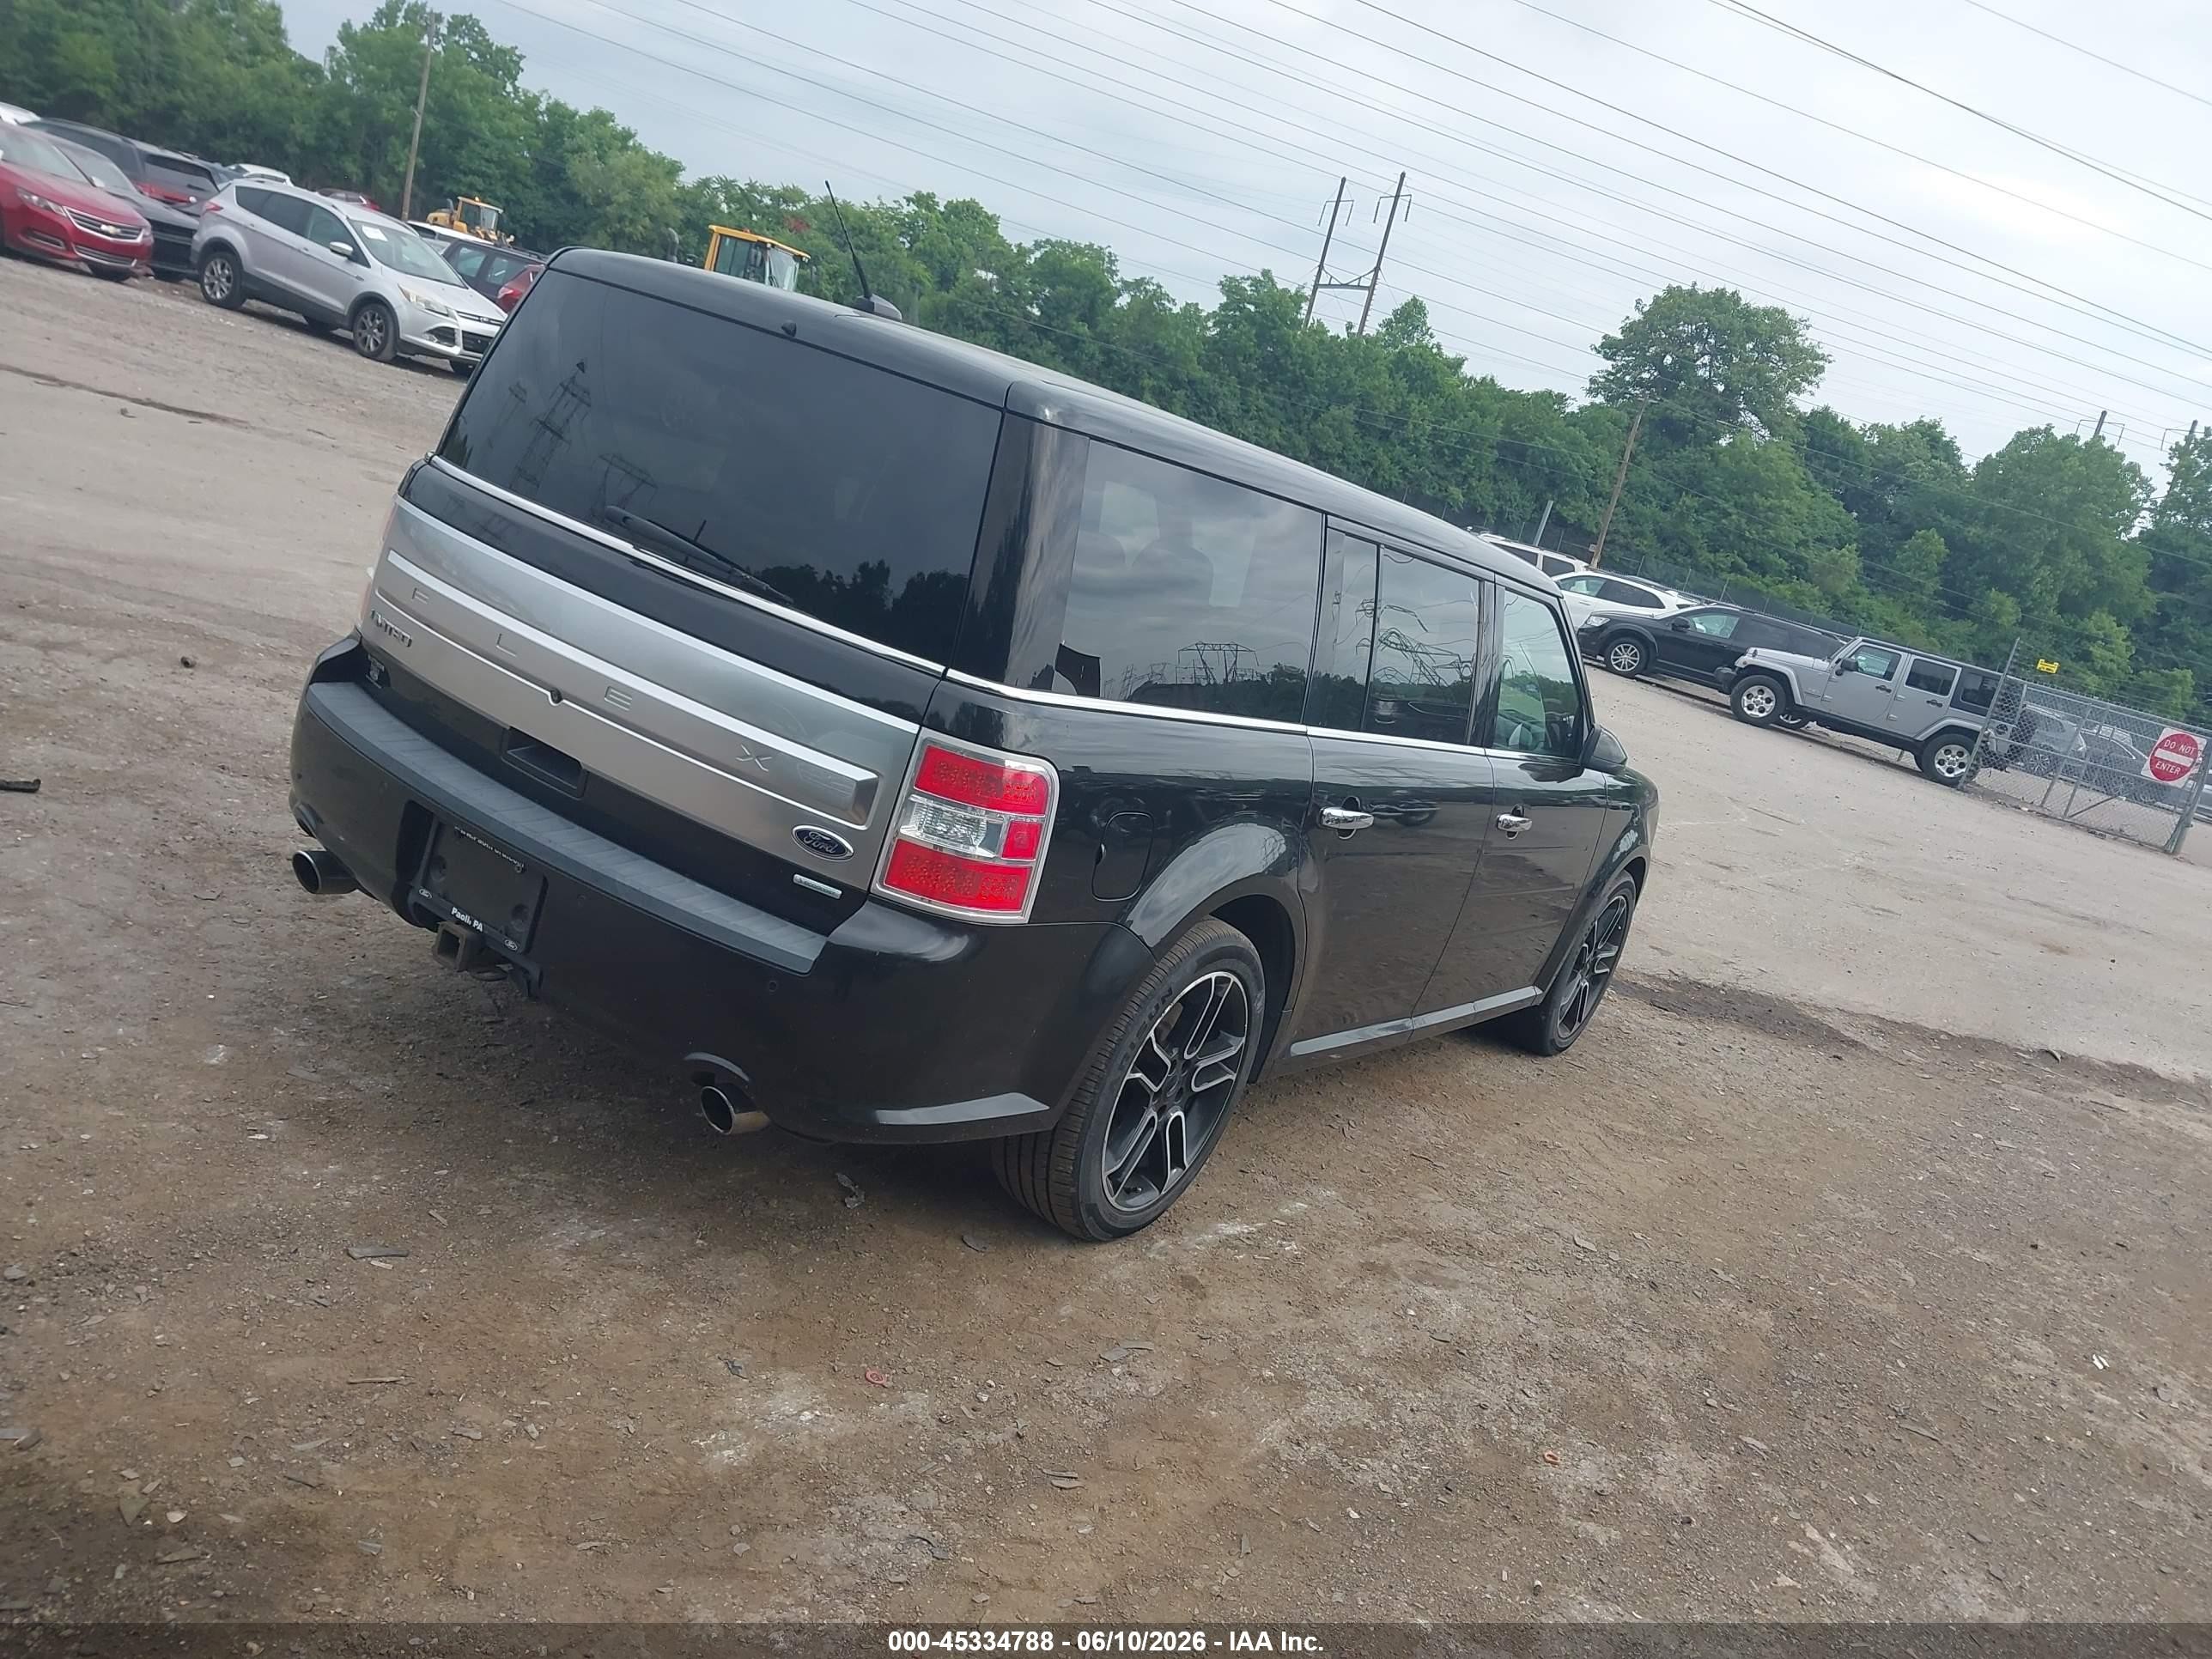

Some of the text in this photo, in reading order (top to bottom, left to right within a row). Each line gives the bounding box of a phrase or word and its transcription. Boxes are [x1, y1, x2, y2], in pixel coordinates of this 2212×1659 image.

[2164, 739, 2197, 755] DO NOT
[2155, 761, 2181, 775] ENTER
[472, 920, 483, 932] PA
